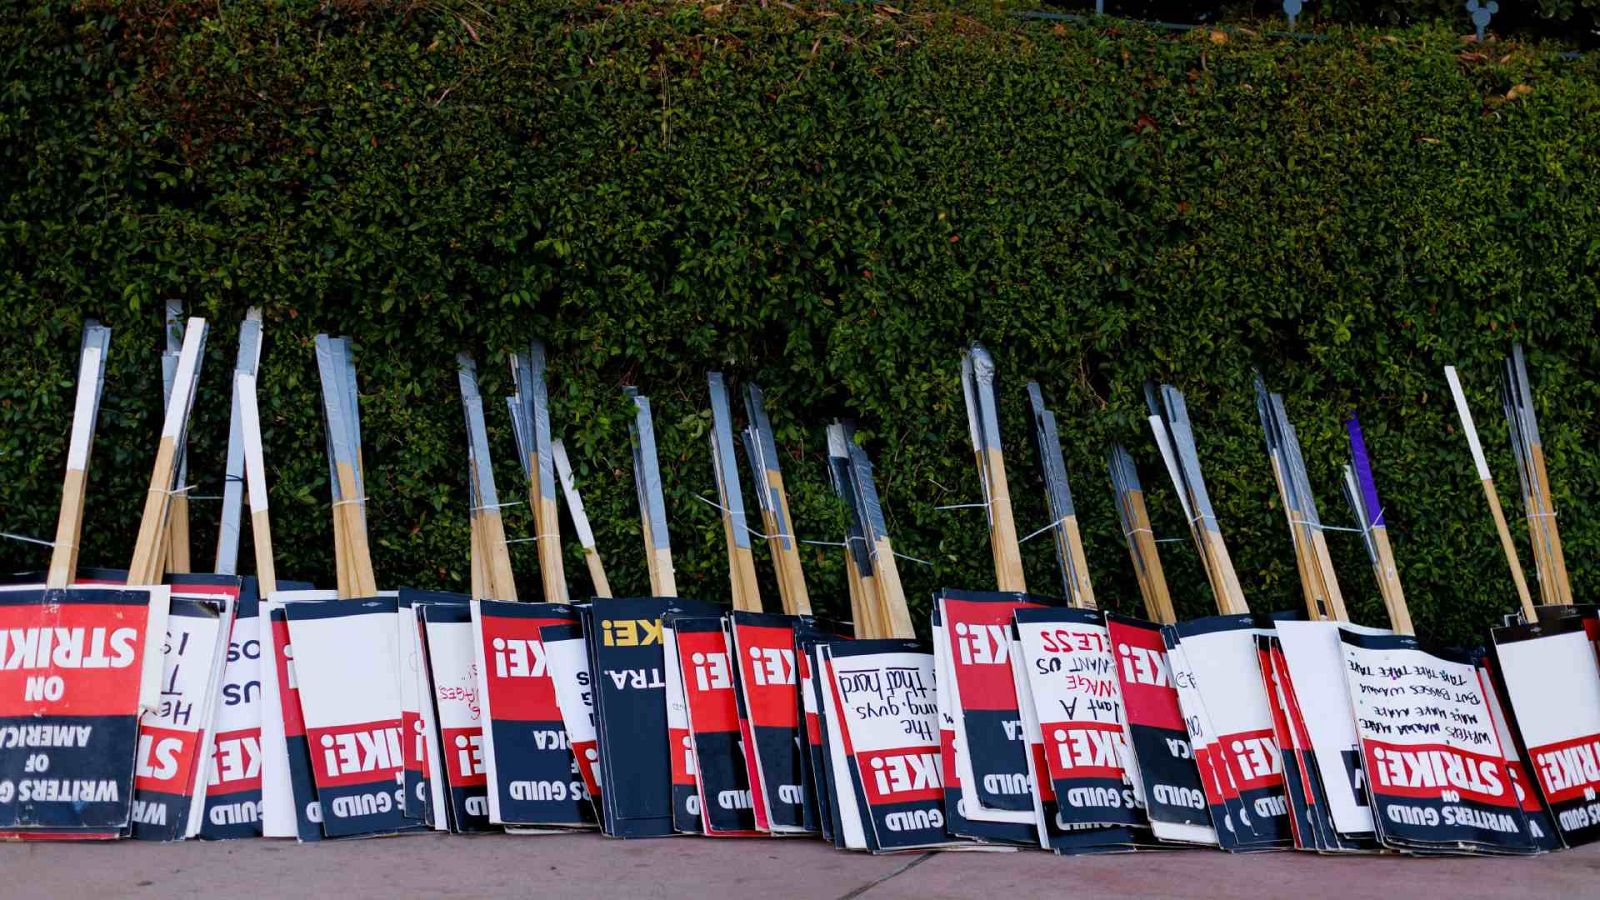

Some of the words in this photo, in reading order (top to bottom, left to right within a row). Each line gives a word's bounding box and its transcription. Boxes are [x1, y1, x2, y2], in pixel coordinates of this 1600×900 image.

[1036, 658, 1061, 675] US
[1378, 665, 1411, 680] TAKE
[25, 676, 64, 700] ON
[838, 669, 882, 703] hard
[885, 668, 927, 696] that
[1359, 683, 1404, 697] WANNA
[1058, 697, 1077, 720] A
[1451, 692, 1480, 706] BUT
[1373, 706, 1410, 717] MAKE
[1416, 706, 1447, 720] MAKE
[900, 719, 932, 741] the
[25, 754, 49, 772] OF
[1374, 747, 1504, 797] STRIKE!
[18, 780, 118, 802] WRITERS
[509, 781, 566, 800] GUILD
[1067, 787, 1120, 808] GUILD
[1153, 783, 1205, 810] GUILD
[1441, 790, 1460, 802] ON
[332, 791, 391, 817] GUILD
[1387, 804, 1439, 826] GUILD
[885, 809, 943, 831] GUILD
[1441, 806, 1519, 834] WRITERS
[1559, 808, 1588, 831] GUILD
